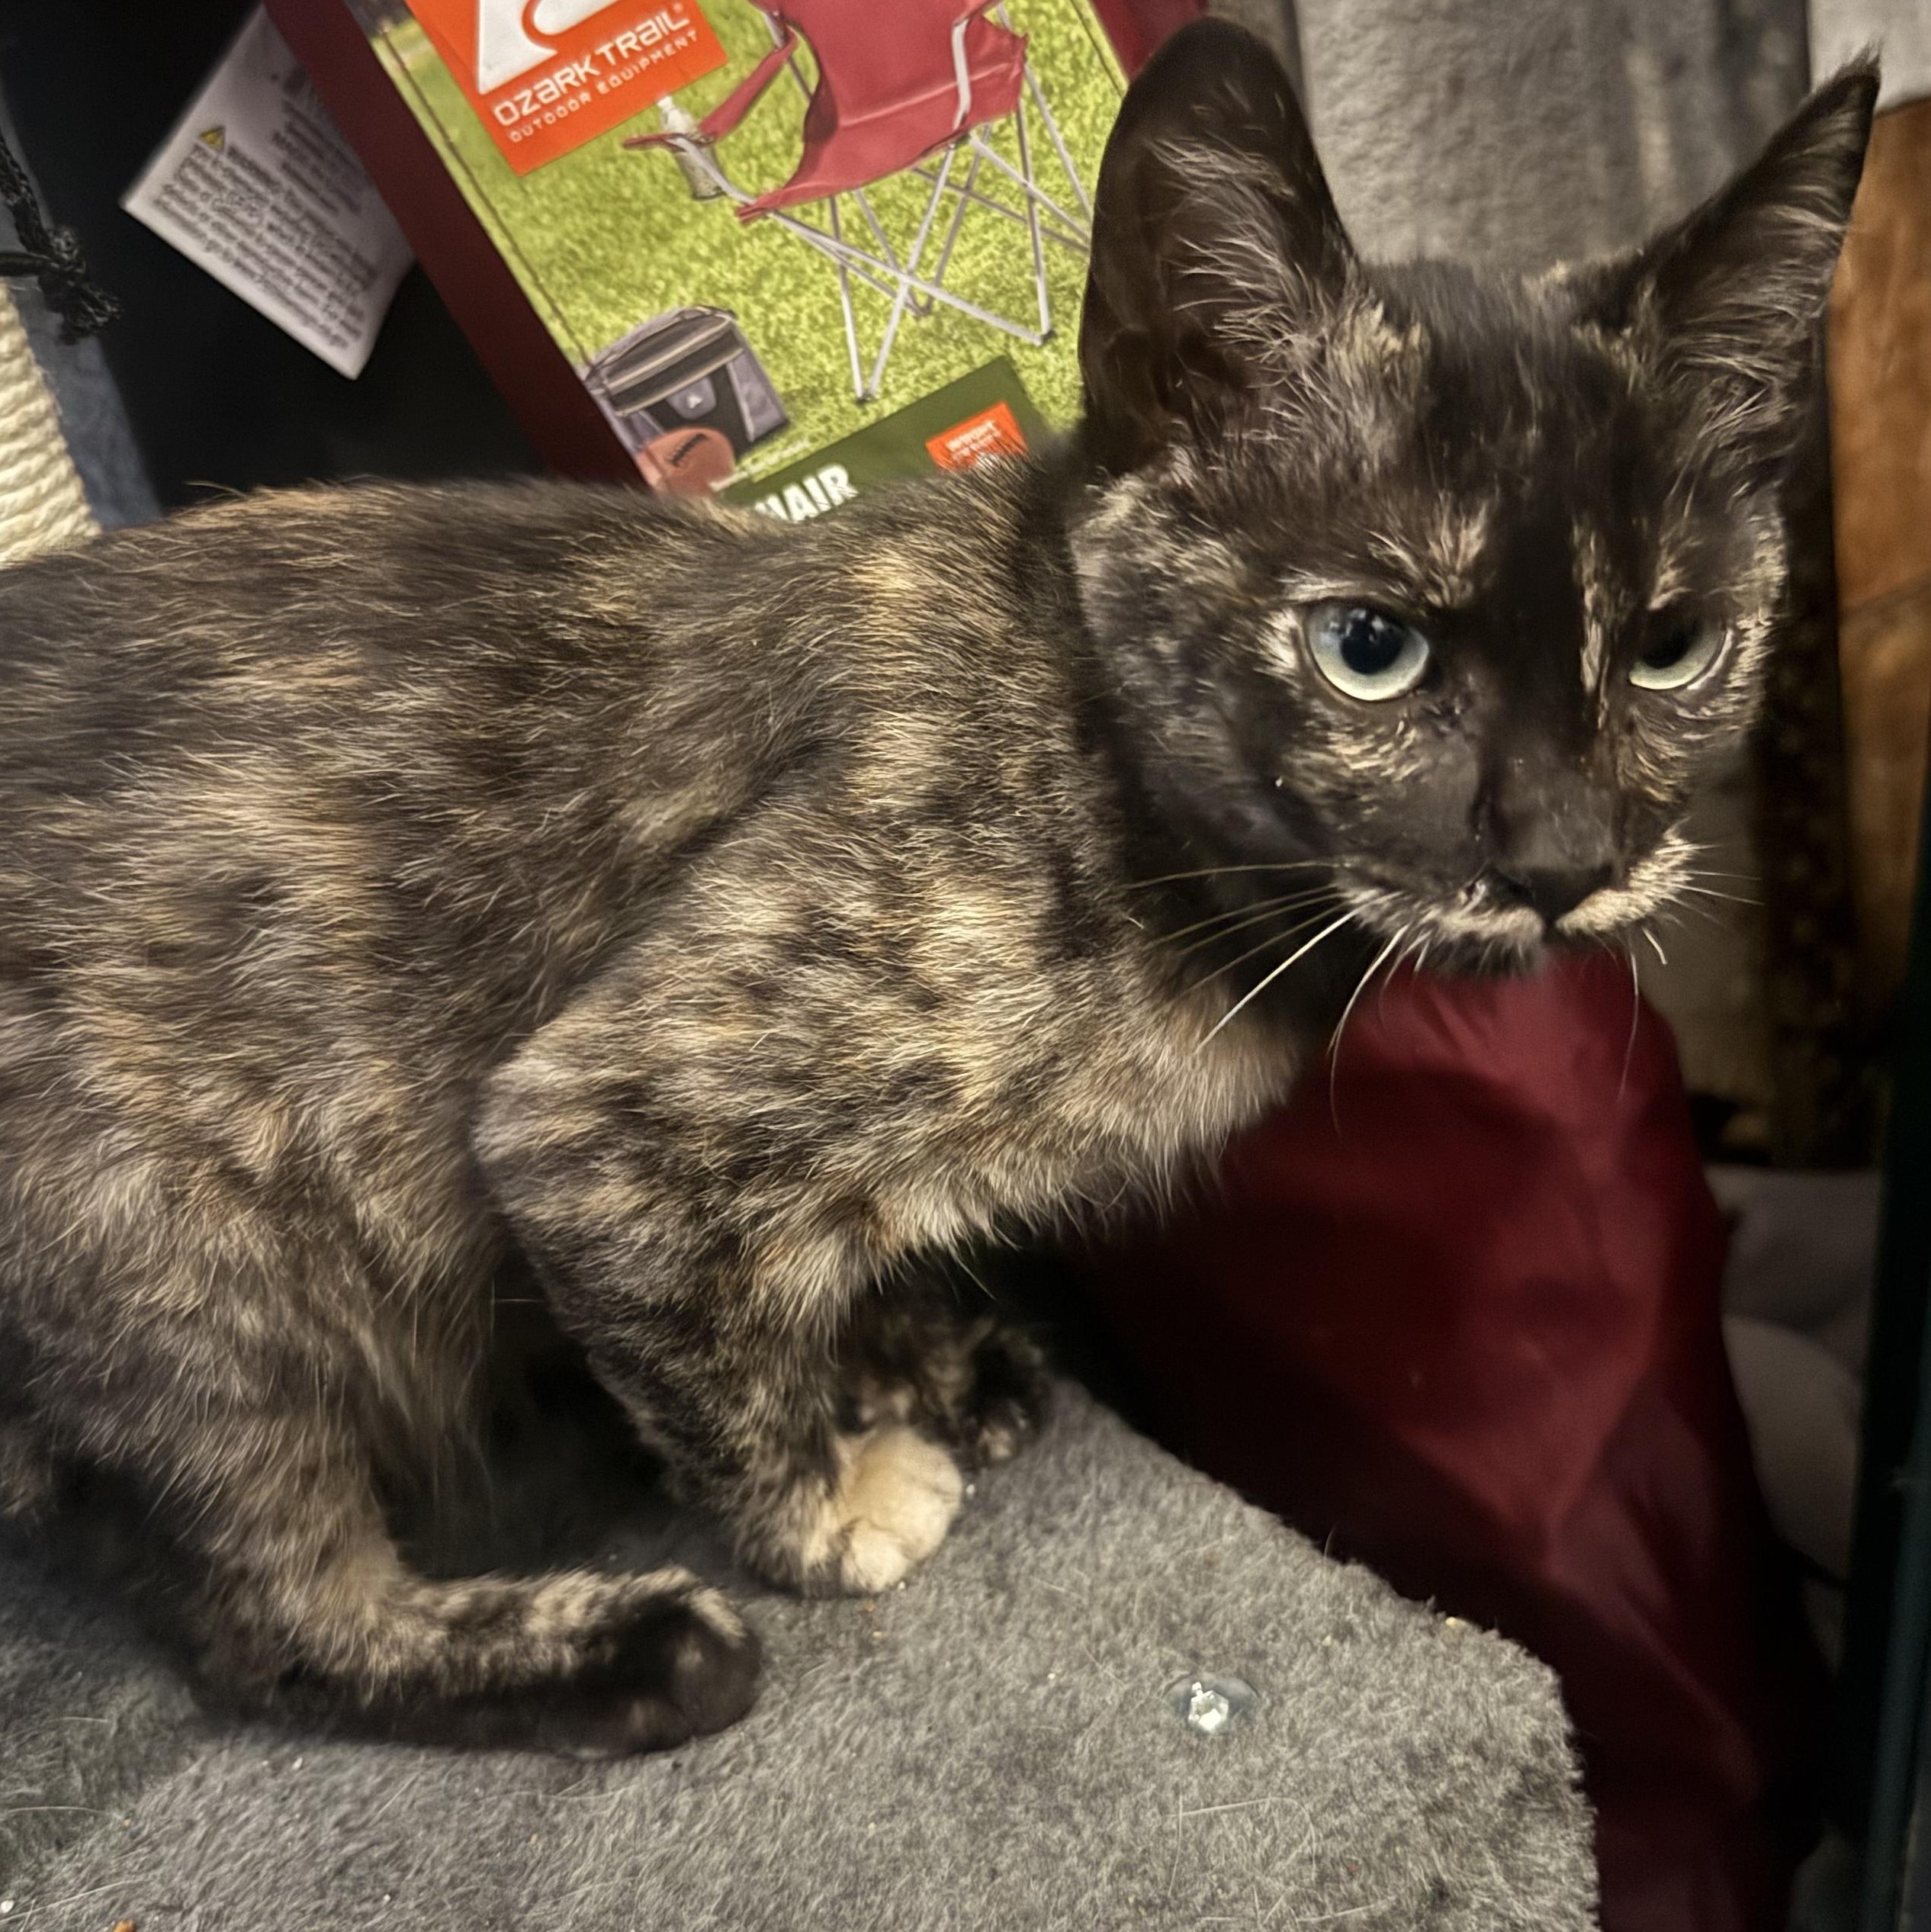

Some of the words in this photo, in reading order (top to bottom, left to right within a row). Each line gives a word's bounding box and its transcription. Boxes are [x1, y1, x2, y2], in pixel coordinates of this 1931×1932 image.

[494, 54, 600, 126] OZARK
[595, 11, 689, 66] TRAIL
[509, 92, 591, 143] OUTDOOR
[596, 29, 696, 95] EQUIPMENT
